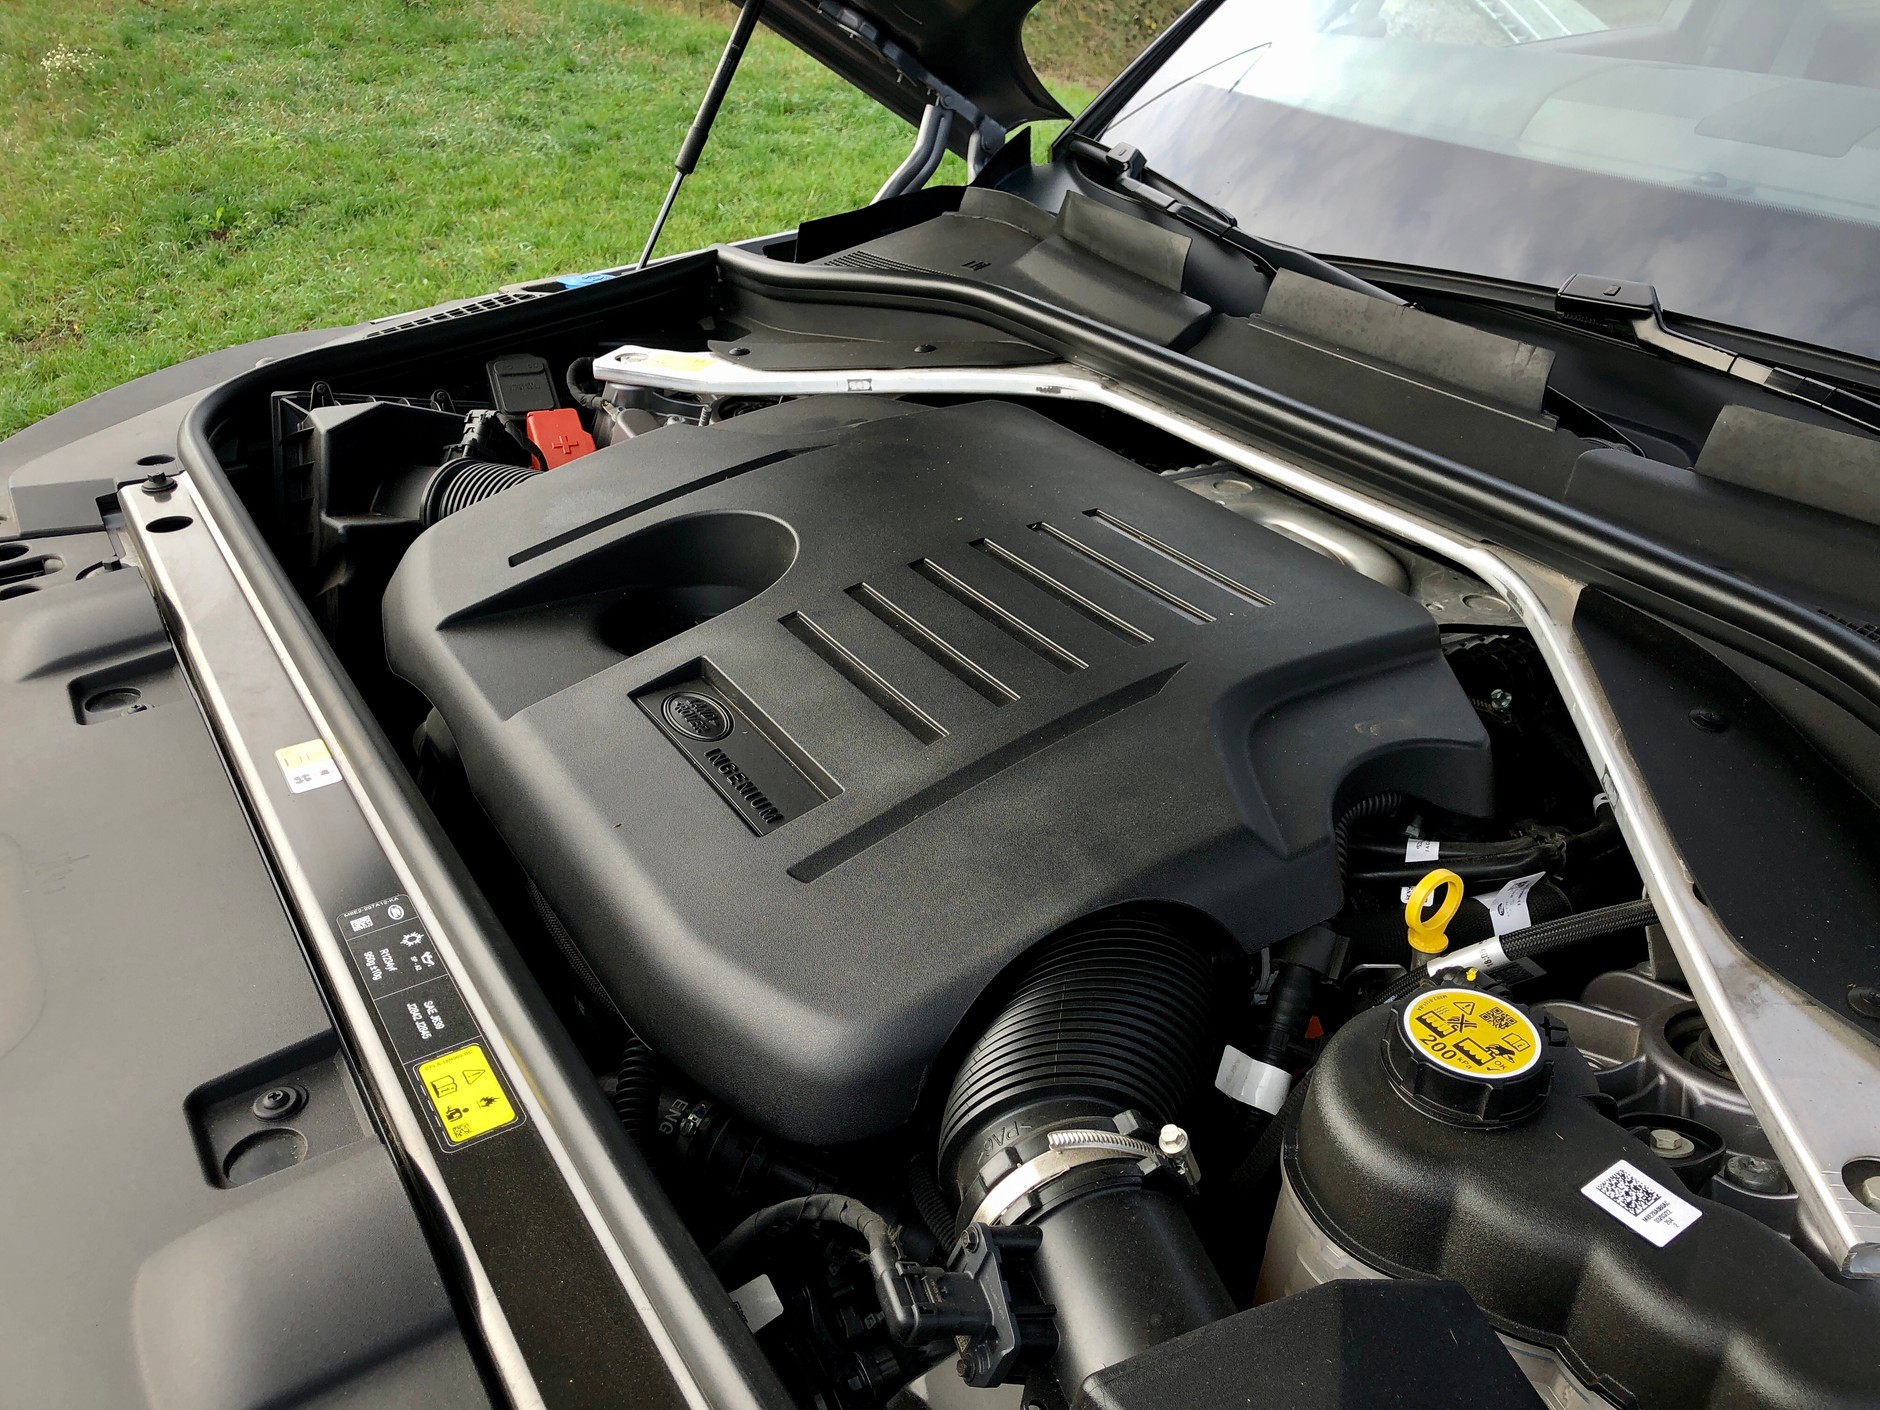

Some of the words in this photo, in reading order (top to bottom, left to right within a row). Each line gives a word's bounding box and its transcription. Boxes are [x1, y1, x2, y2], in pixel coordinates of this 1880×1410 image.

[675, 703, 711, 734] ROVER
[704, 748, 785, 824] INGENIUM
[380, 948, 398, 972] R1234yf
[424, 1000, 437, 1016] SAE
[430, 1014, 445, 1029] J639
[1420, 1035, 1457, 1060] 200
[1456, 1057, 1473, 1069] kPa
[1494, 1060, 1508, 1071] OK
[658, 1098, 688, 1134] ENG
